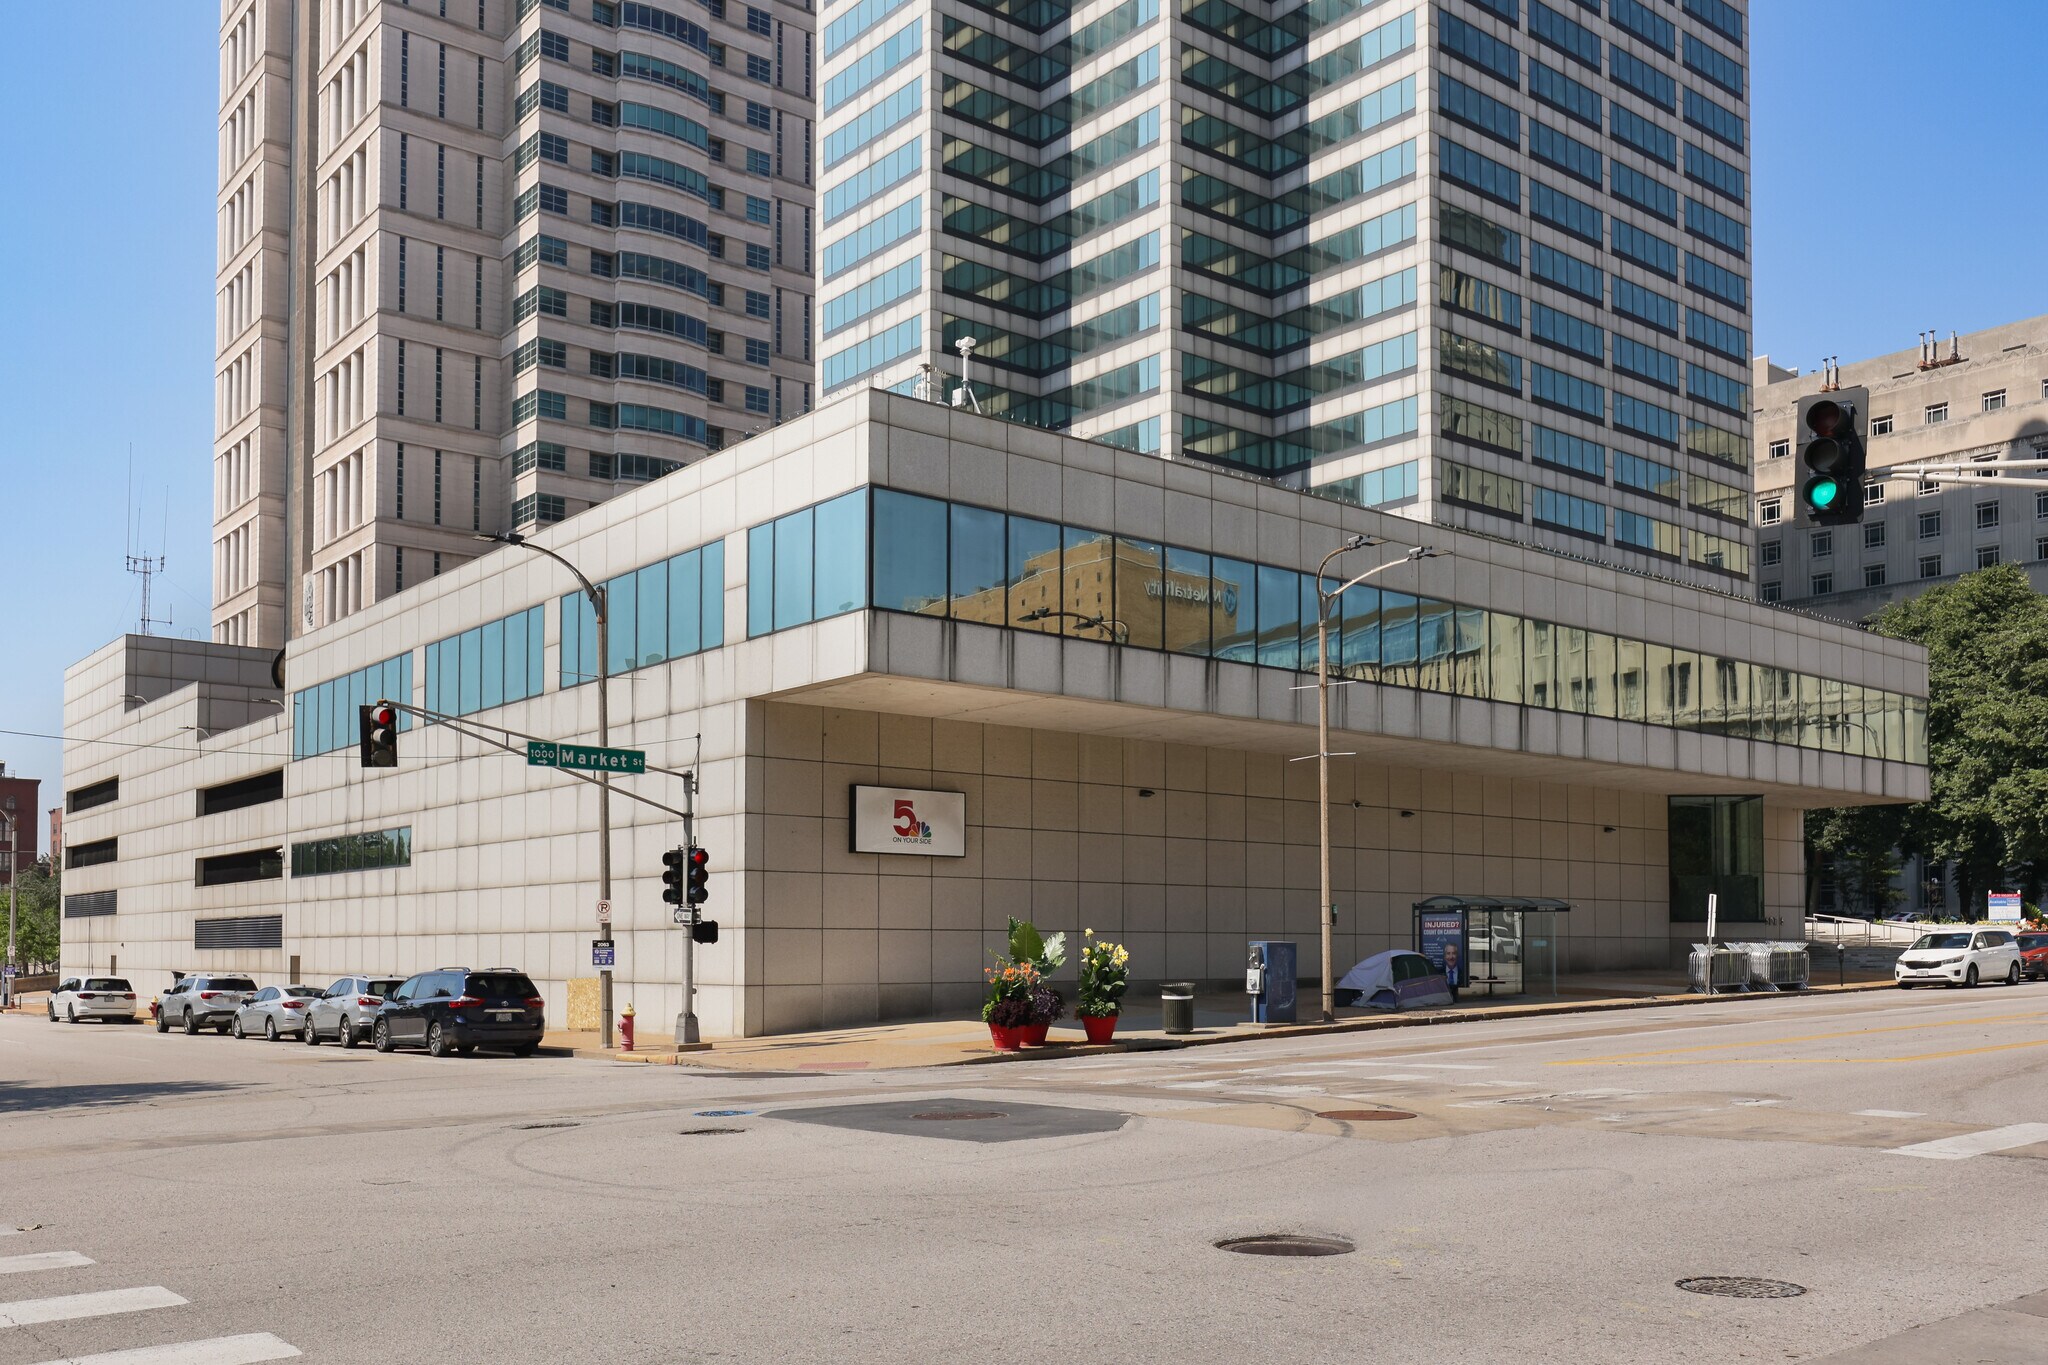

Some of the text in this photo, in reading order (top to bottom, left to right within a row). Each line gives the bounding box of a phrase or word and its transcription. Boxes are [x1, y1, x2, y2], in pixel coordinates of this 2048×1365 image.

[530, 749, 643, 768] 1000 Market St
[892, 799, 917, 837] 5
